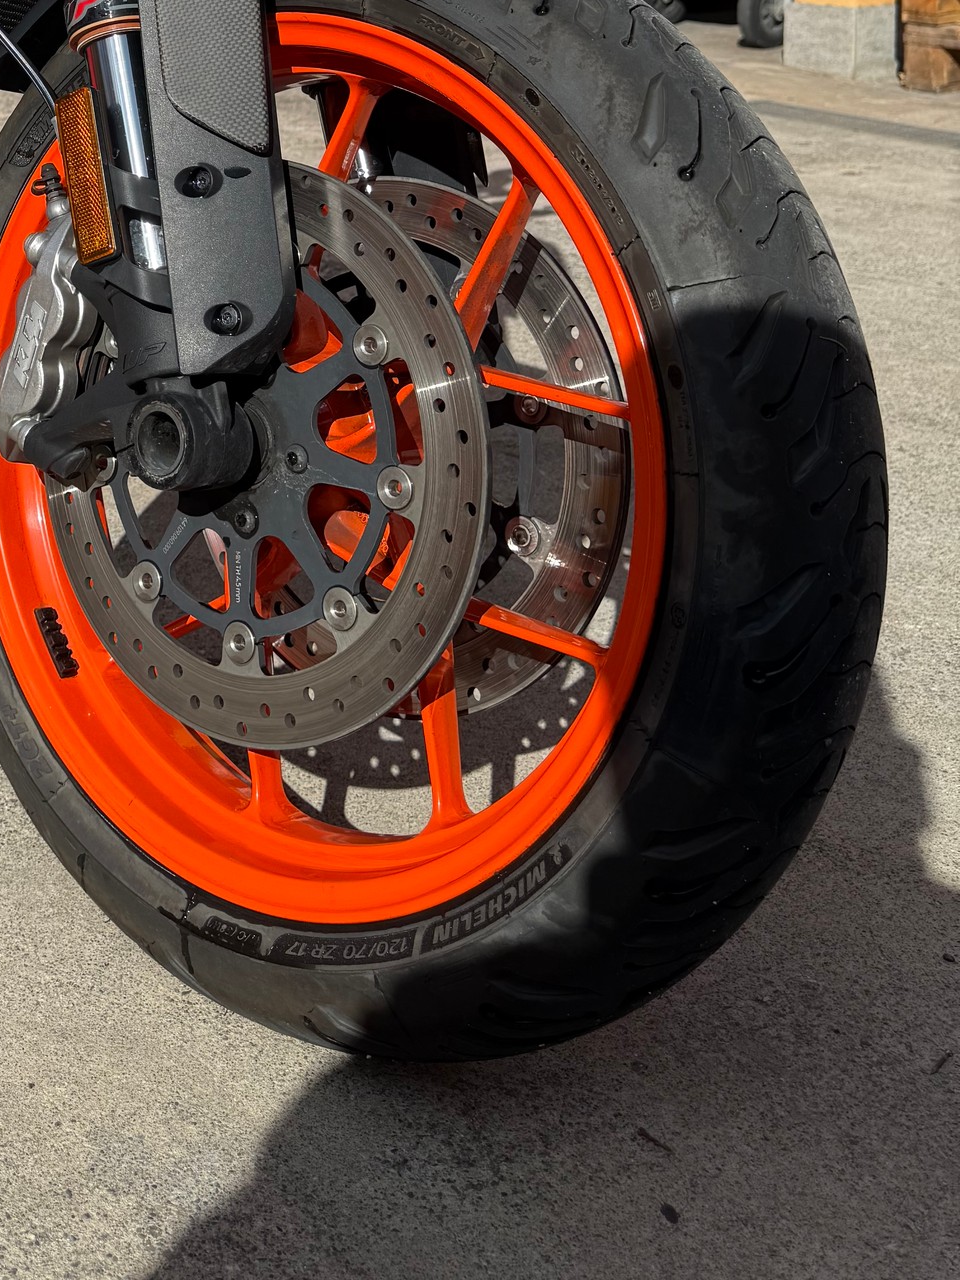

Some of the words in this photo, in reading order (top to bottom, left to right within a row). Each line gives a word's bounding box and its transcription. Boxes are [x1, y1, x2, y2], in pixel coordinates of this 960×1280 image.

[415, 13, 468, 48] FRONT
[432, 860, 546, 945] MICHELIN
[284, 941, 308, 957] 17
[311, 944, 339, 960] ZR
[343, 937, 408, 960] 120/70
